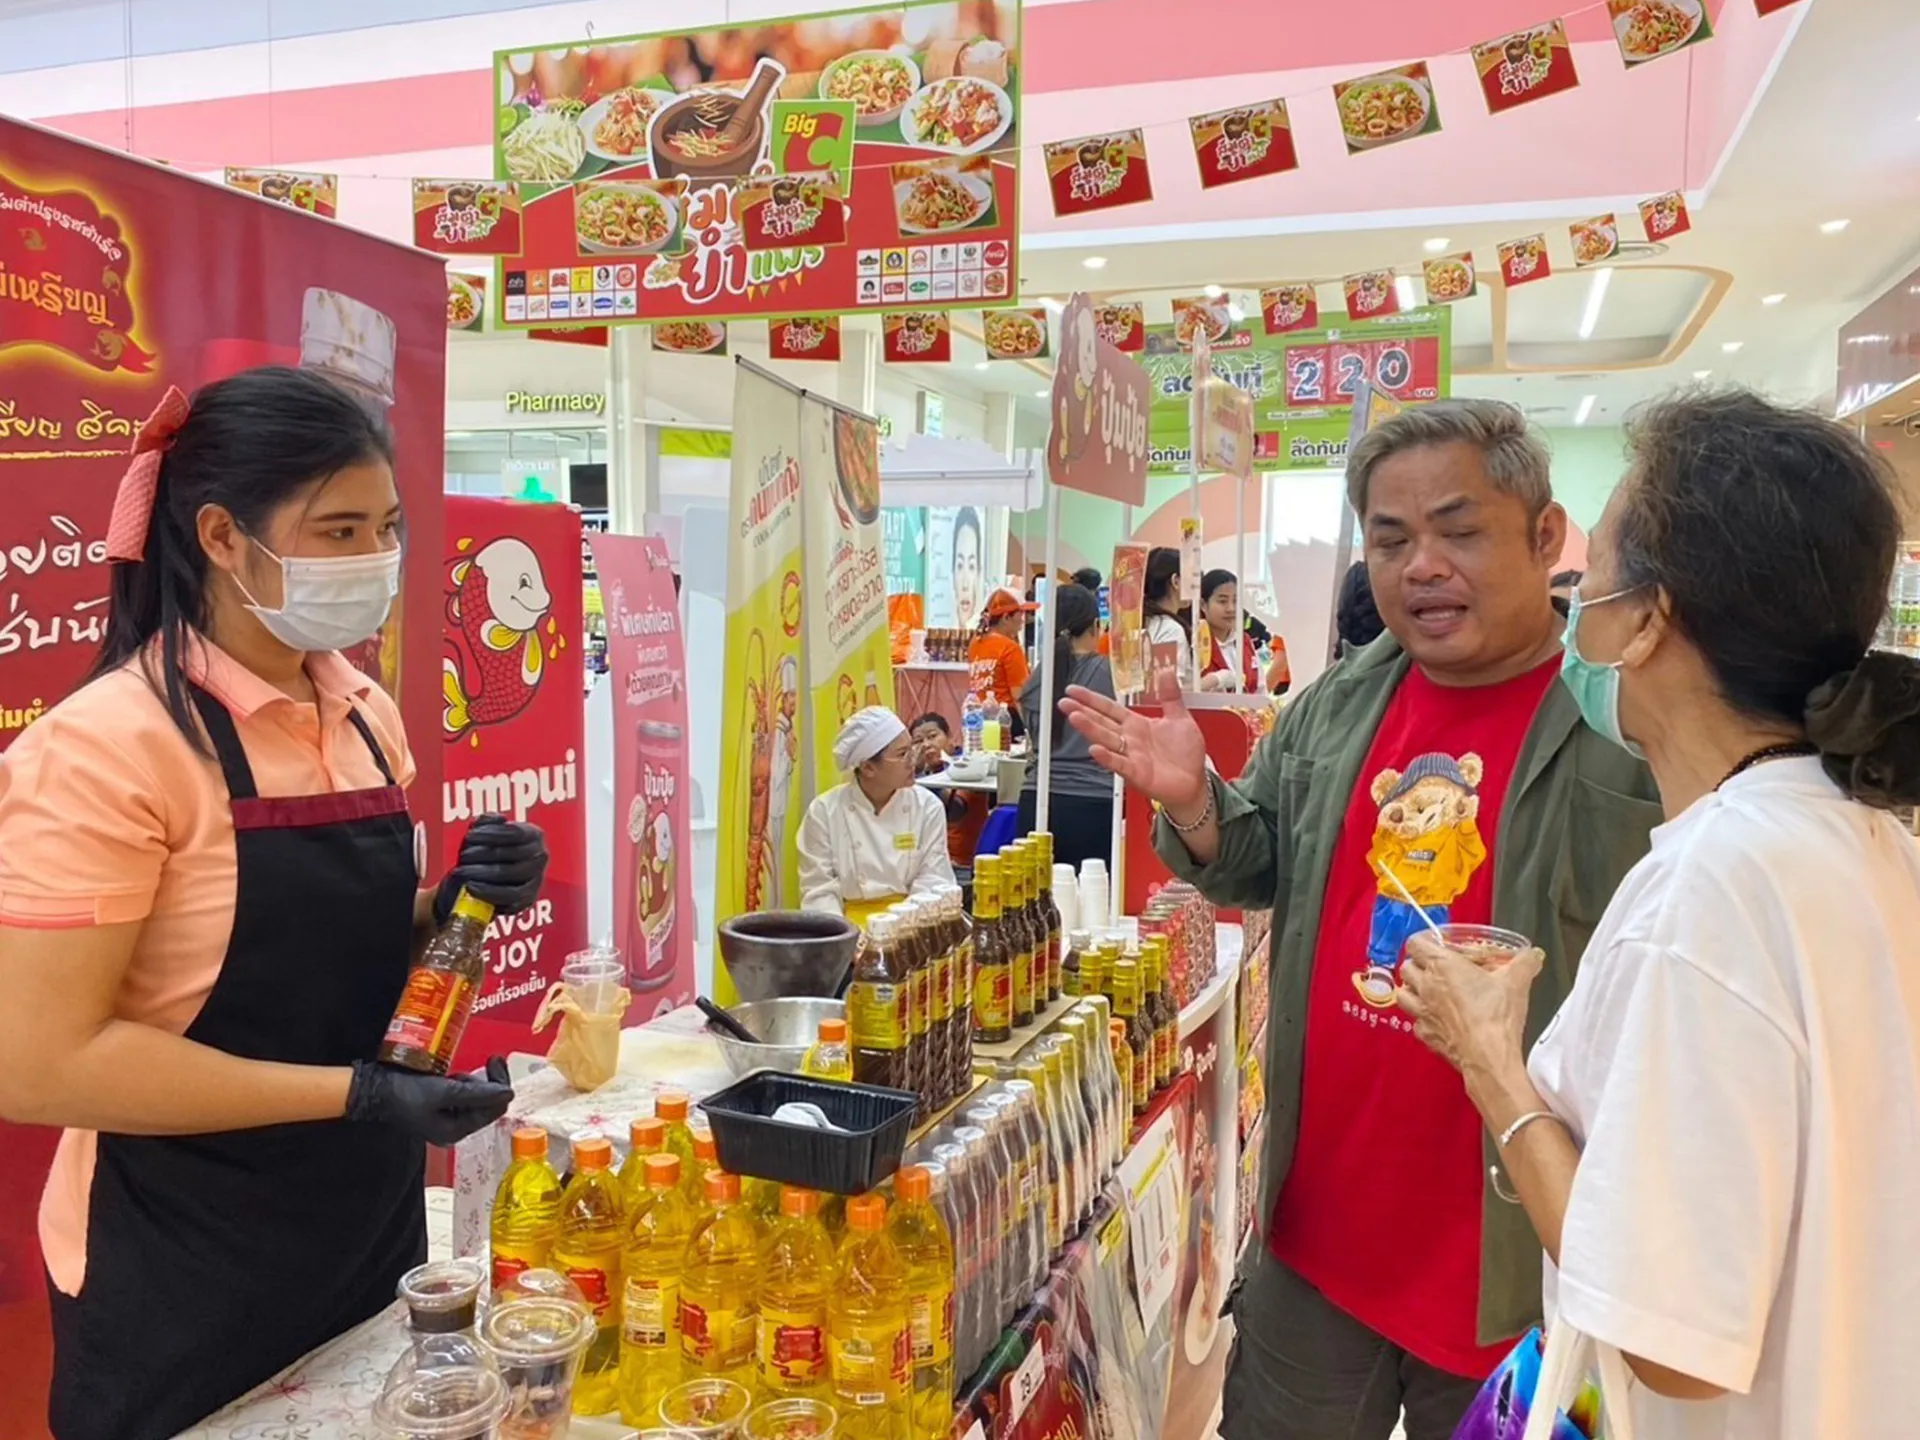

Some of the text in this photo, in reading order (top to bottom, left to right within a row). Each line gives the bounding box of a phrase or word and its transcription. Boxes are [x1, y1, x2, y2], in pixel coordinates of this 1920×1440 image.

[783, 112, 844, 173] C
[785, 115, 817, 137] Big
[0, 193, 122, 261] มตำปรุงรสสำเร็จ
[505, 390, 605, 416] Pharmacy
[442, 748, 578, 822] umpui
[481, 898, 554, 945] AVOR
[493, 933, 543, 975] JOY
